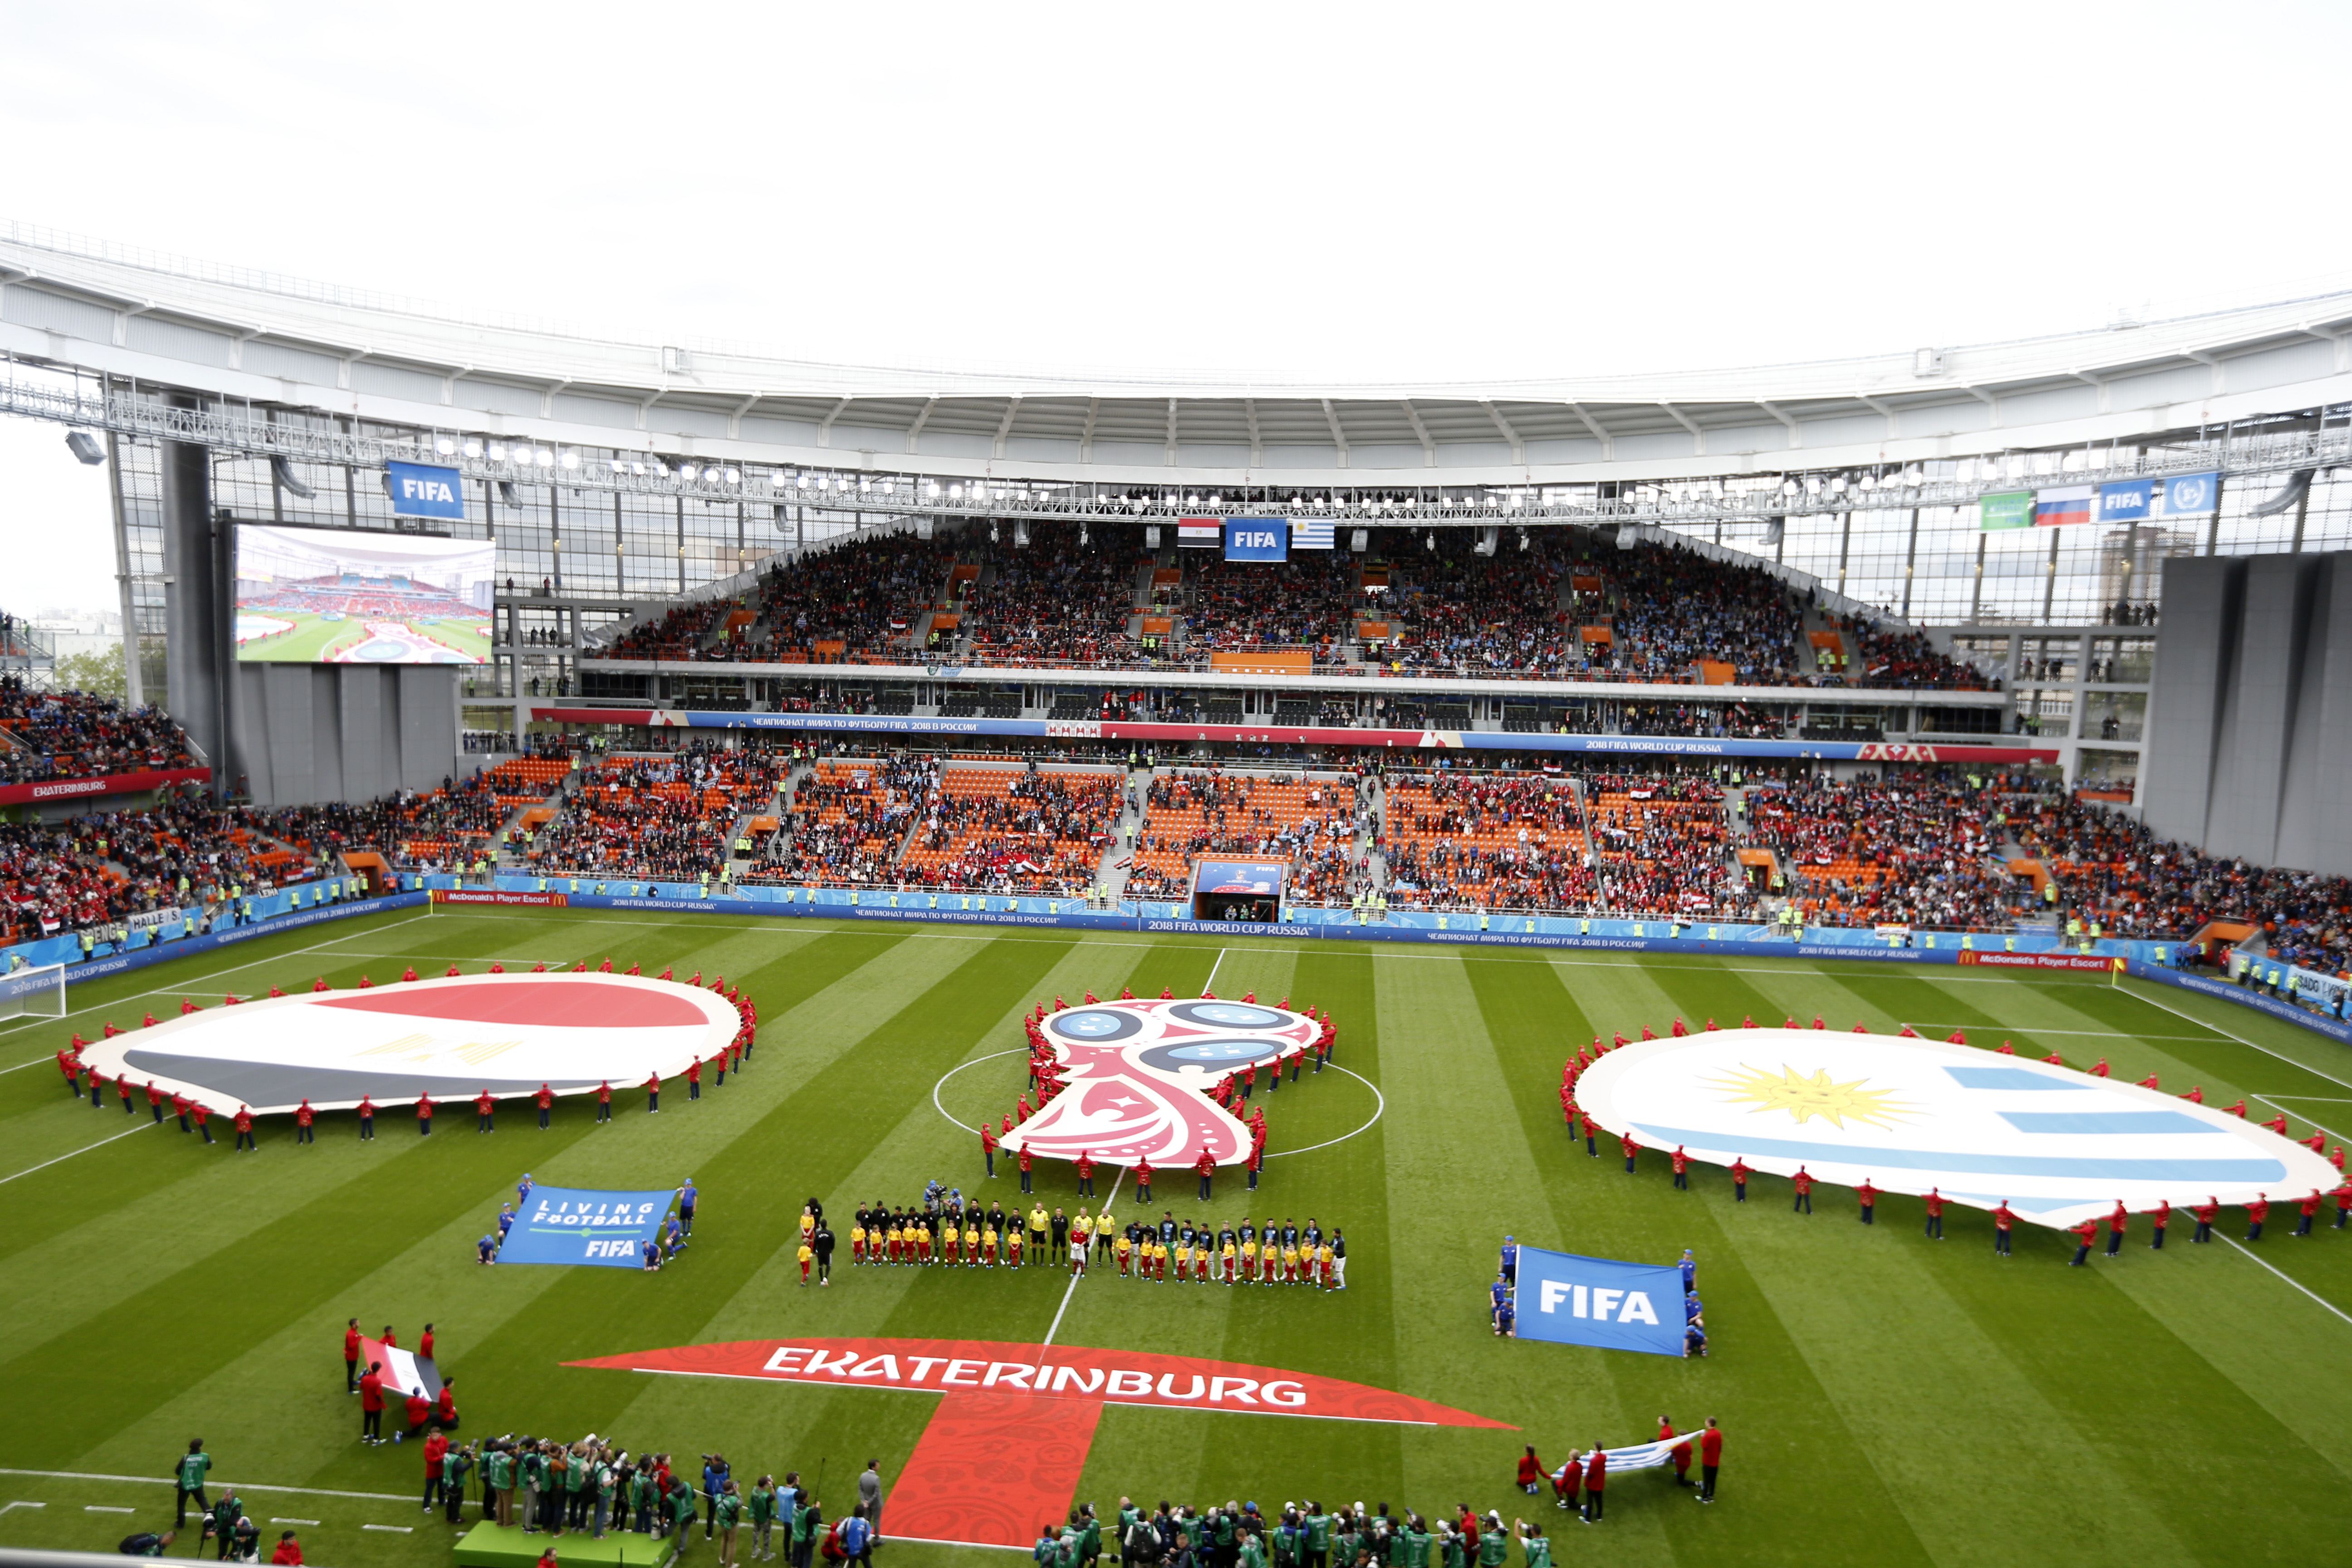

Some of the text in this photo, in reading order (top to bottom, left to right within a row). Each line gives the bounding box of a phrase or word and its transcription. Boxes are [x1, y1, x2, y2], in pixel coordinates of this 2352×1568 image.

[403, 479, 454, 502] FIFA
[2105, 491, 2143, 510] FIFA
[1235, 532, 1277, 547] FIFA
[753, 718, 805, 726] ЧЕМПИОНАТ
[848, 720, 888, 729] ФУТБОЛУ
[911, 722, 931, 730] 2018
[1586, 741, 1607, 749] 2018
[1608, 741, 1628, 750] FIFA
[1629, 742, 1663, 751] WORLD
[1665, 743, 1685, 751] CUP
[34, 781, 106, 797] EKATERINBURG
[449, 893, 549, 904] McDonald's Player Escort
[855, 909, 903, 917] ЧЕМПИОНАТ
[941, 912, 978, 921] ФУТБОЛУ
[1148, 921, 1173, 930] 2018
[1175, 921, 1198, 931] FIFA
[1200, 922, 1240, 933] WORLD
[1241, 924, 1265, 934] CUP
[1427, 932, 1479, 941] ЧЕМПИОНАТ
[1480, 934, 1505, 943] МИРА
[1507, 935, 1519, 943] ПО
[1521, 936, 1560, 945] ФУТБОЛУ
[1562, 938, 1579, 946] FIFA
[1837, 948, 1867, 956] WORLD
[1980, 955, 2106, 968] McDonald's Player Escort
[82, 966, 98, 976] CUP
[539, 1200, 654, 1213] LIVING
[585, 1240, 635, 1257] FIFA
[1540, 1279, 1659, 1325] FIFA
[761, 1346, 1307, 1407] EKATERINBURG
